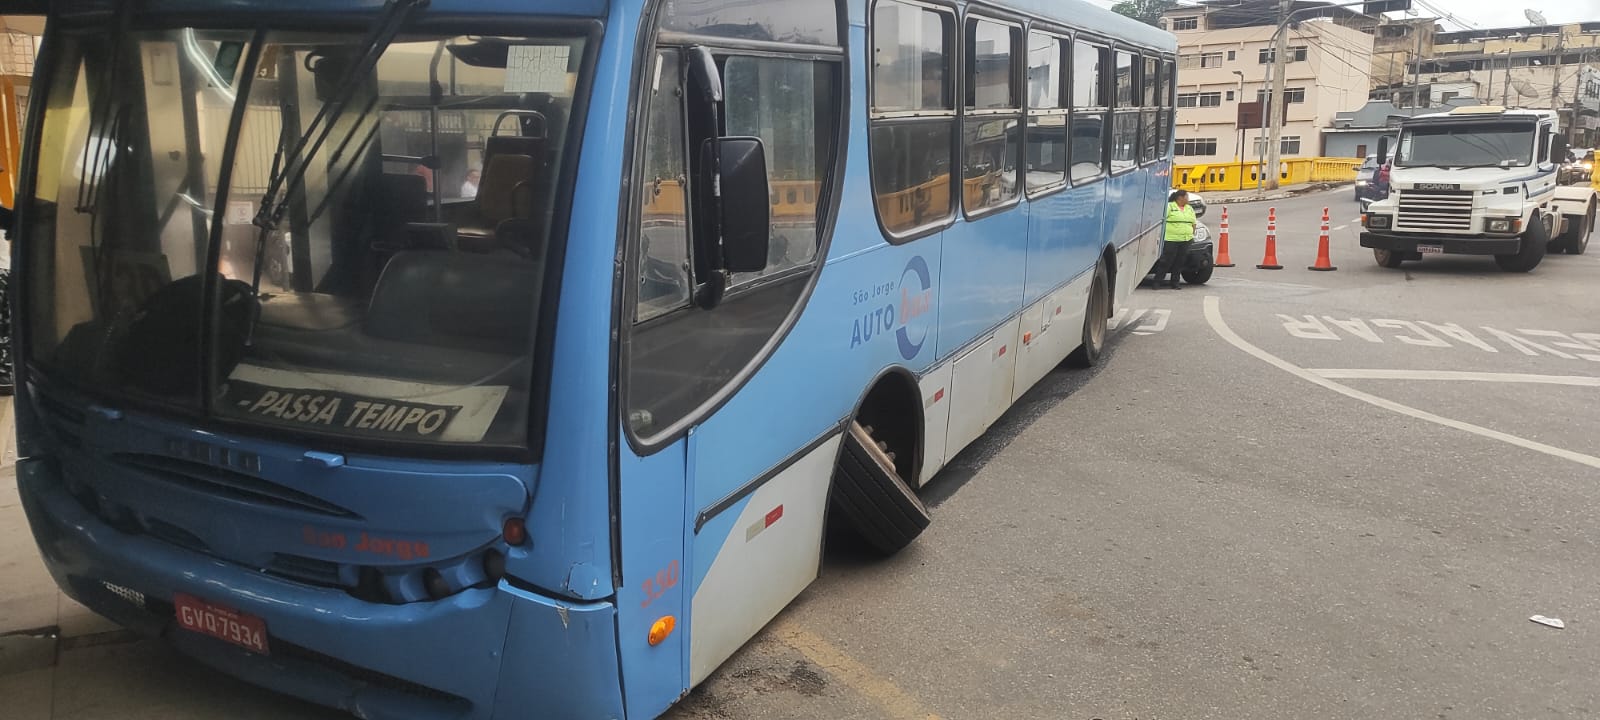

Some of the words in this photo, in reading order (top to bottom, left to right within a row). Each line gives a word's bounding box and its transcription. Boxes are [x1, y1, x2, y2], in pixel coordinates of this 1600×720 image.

[872, 281, 895, 298] Jorge
[850, 303, 895, 350] AUTO
[344, 401, 446, 435] TEMPO
